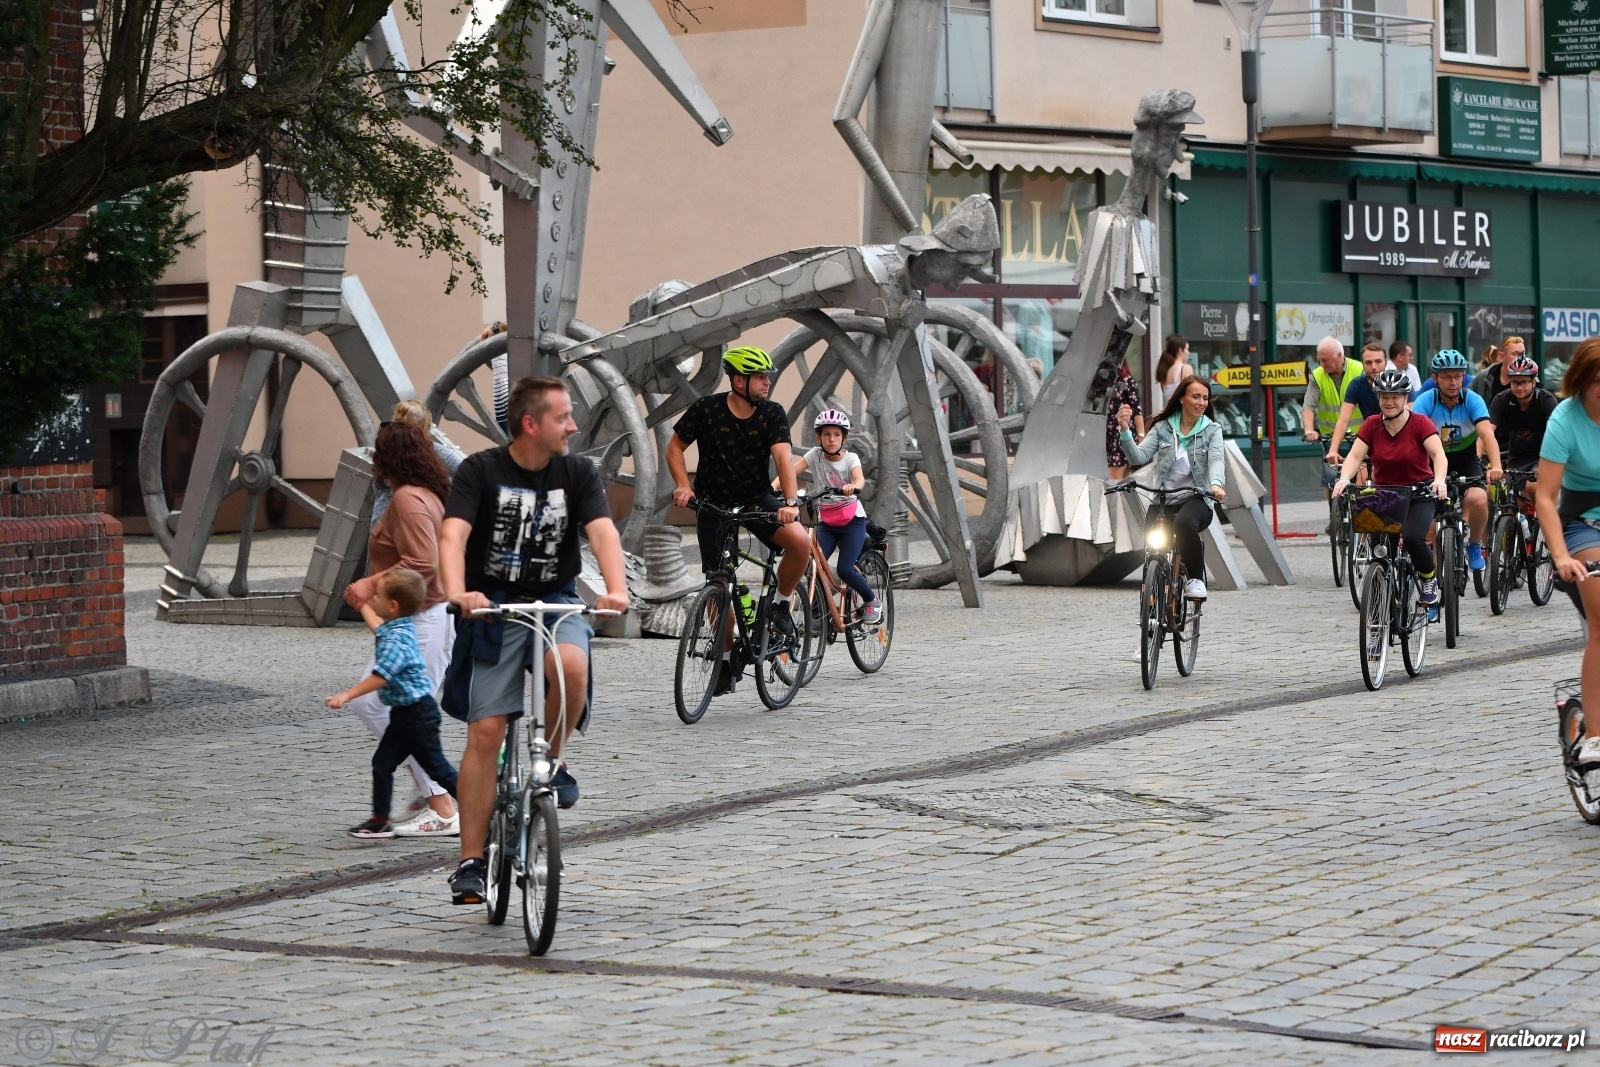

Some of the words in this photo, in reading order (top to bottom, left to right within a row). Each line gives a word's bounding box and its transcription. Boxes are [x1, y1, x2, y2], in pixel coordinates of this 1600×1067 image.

[1565, 43, 1597, 51] ADWOKAT
[1464, 92, 1502, 107] KANCELARIE
[1502, 97, 1539, 111] ADWOKACKIE
[921, 181, 1084, 264] TLLA
[1344, 203, 1491, 248] JUBILER
[1379, 252, 1405, 266] 1989
[1443, 249, 1459, 269] M.
[1200, 304, 1222, 319] Pierre
[1308, 311, 1336, 326] Obrączki
[1336, 312, 1344, 324] do
[1203, 314, 1229, 338] Ricaud
[1543, 310, 1600, 338] CASIO
[1227, 368, 1296, 382] JADŁDAJNIA
